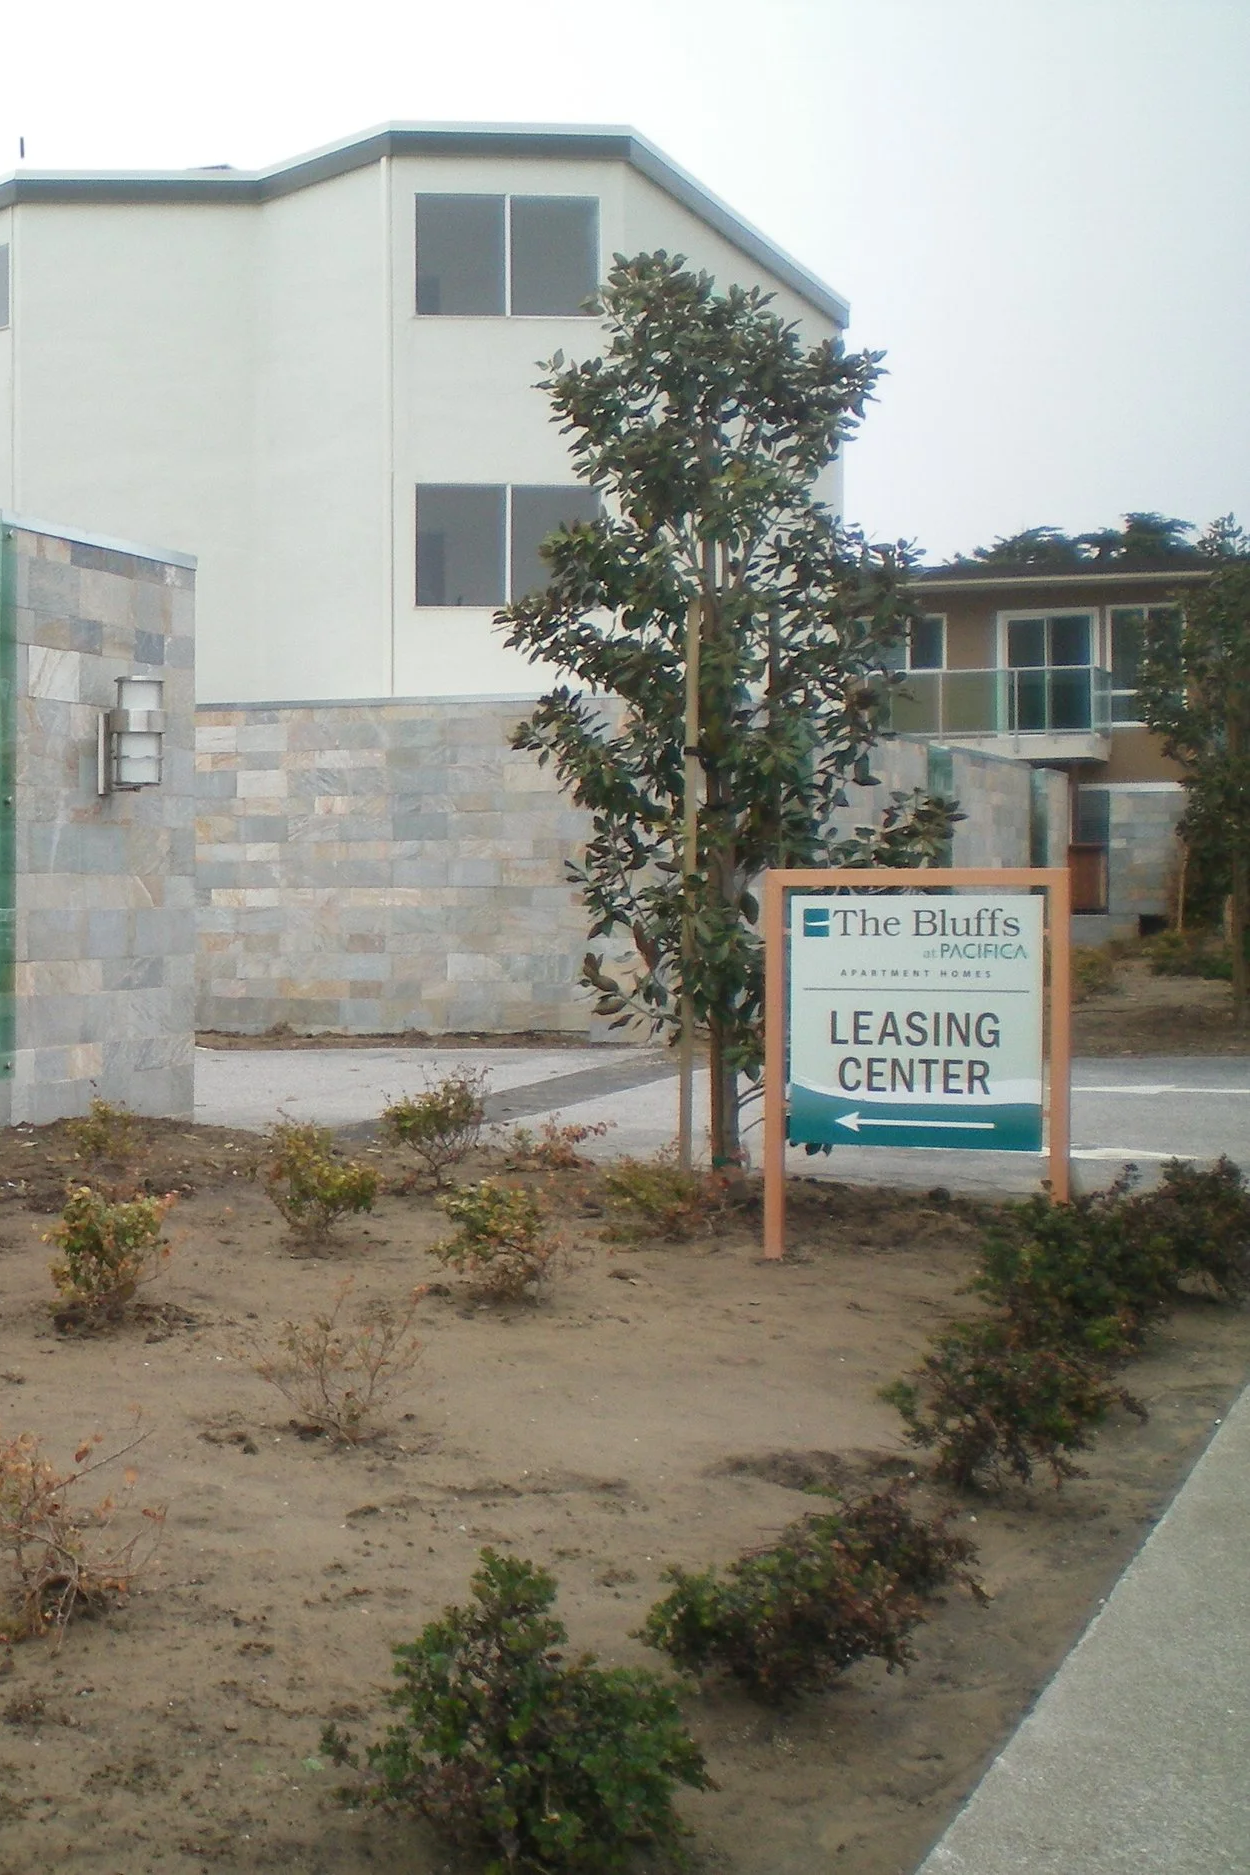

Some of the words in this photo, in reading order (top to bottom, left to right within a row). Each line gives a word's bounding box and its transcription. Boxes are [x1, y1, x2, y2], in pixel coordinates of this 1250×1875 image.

[833, 909, 900, 937] The
[912, 908, 1021, 937] Bluffs
[940, 943, 1028, 960] PACIFICA
[840, 969, 930, 978] APARTMENT
[940, 969, 992, 979] HOMES
[830, 1010, 1000, 1048] LEASING
[838, 1057, 990, 1095] CENTER
